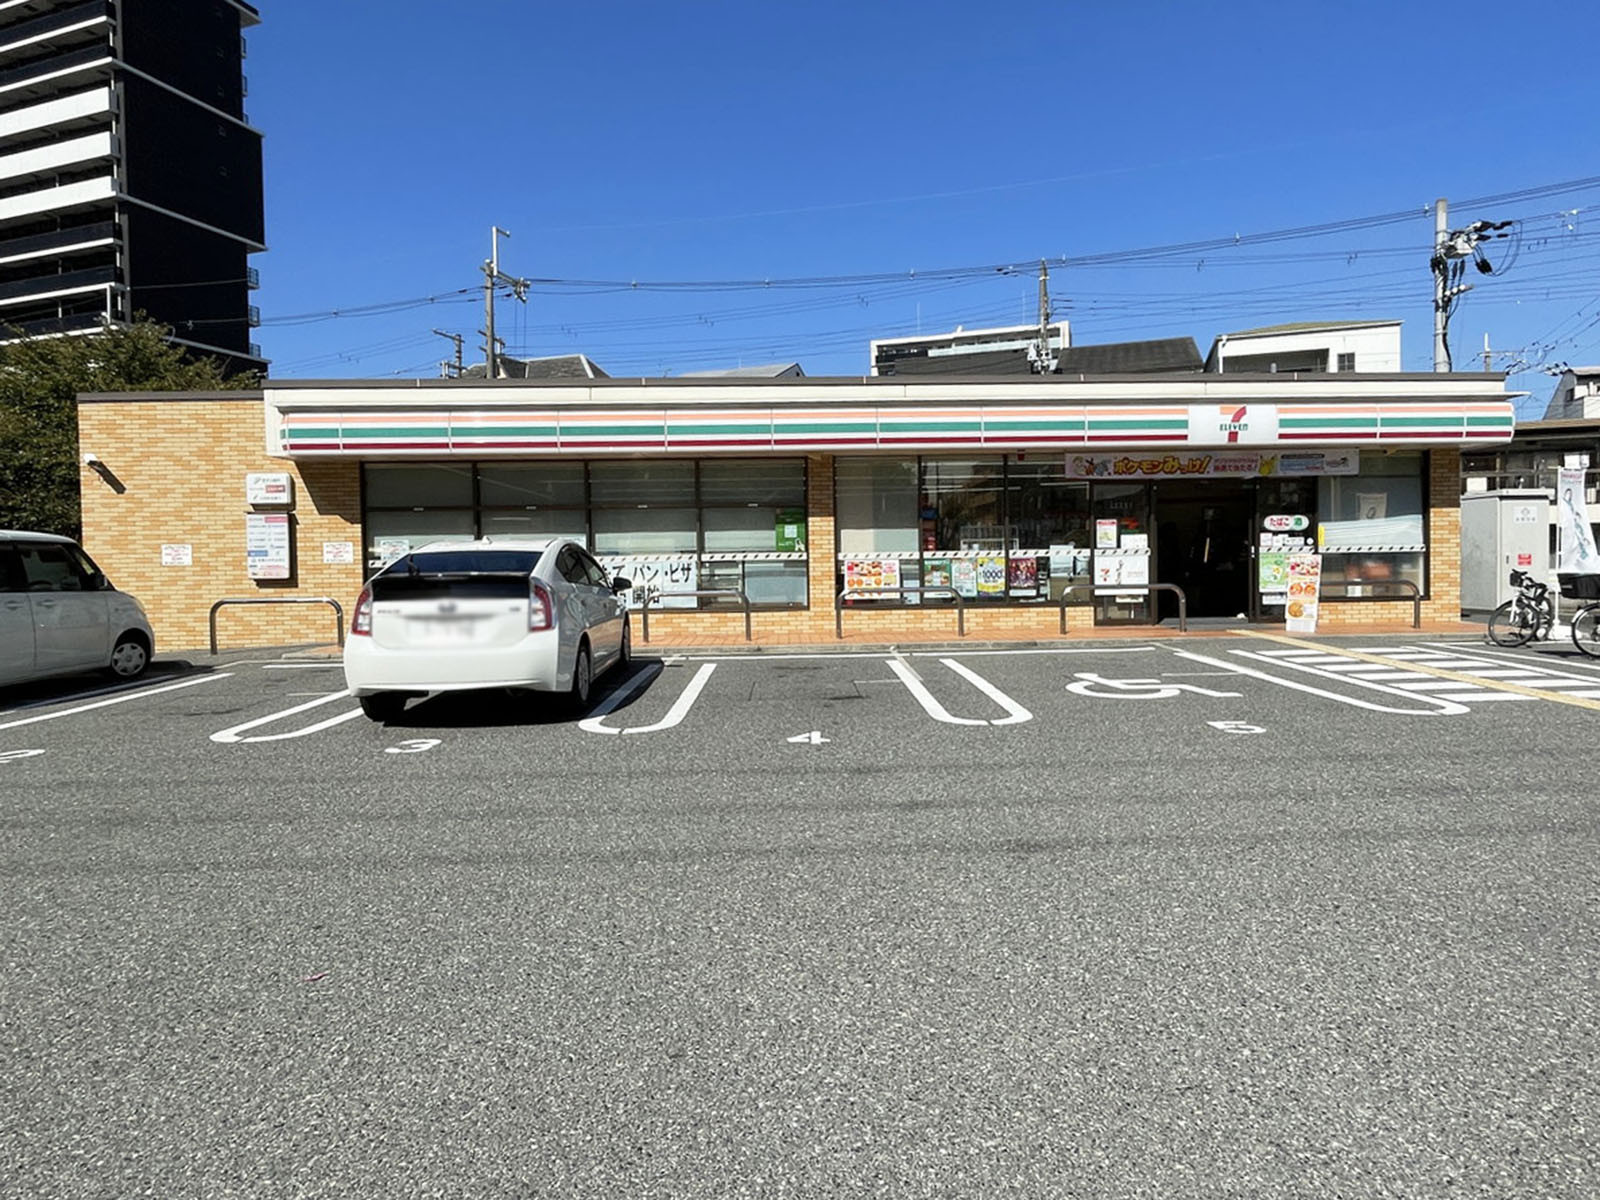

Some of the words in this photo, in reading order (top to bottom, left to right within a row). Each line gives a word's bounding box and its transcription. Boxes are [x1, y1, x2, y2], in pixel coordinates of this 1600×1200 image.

[1220, 406, 1247, 443] 7
[1270, 517, 1290, 526] たばこ
[1207, 720, 1267, 734] 5
[787, 730, 830, 744] 4
[384, 739, 442, 754] 3
